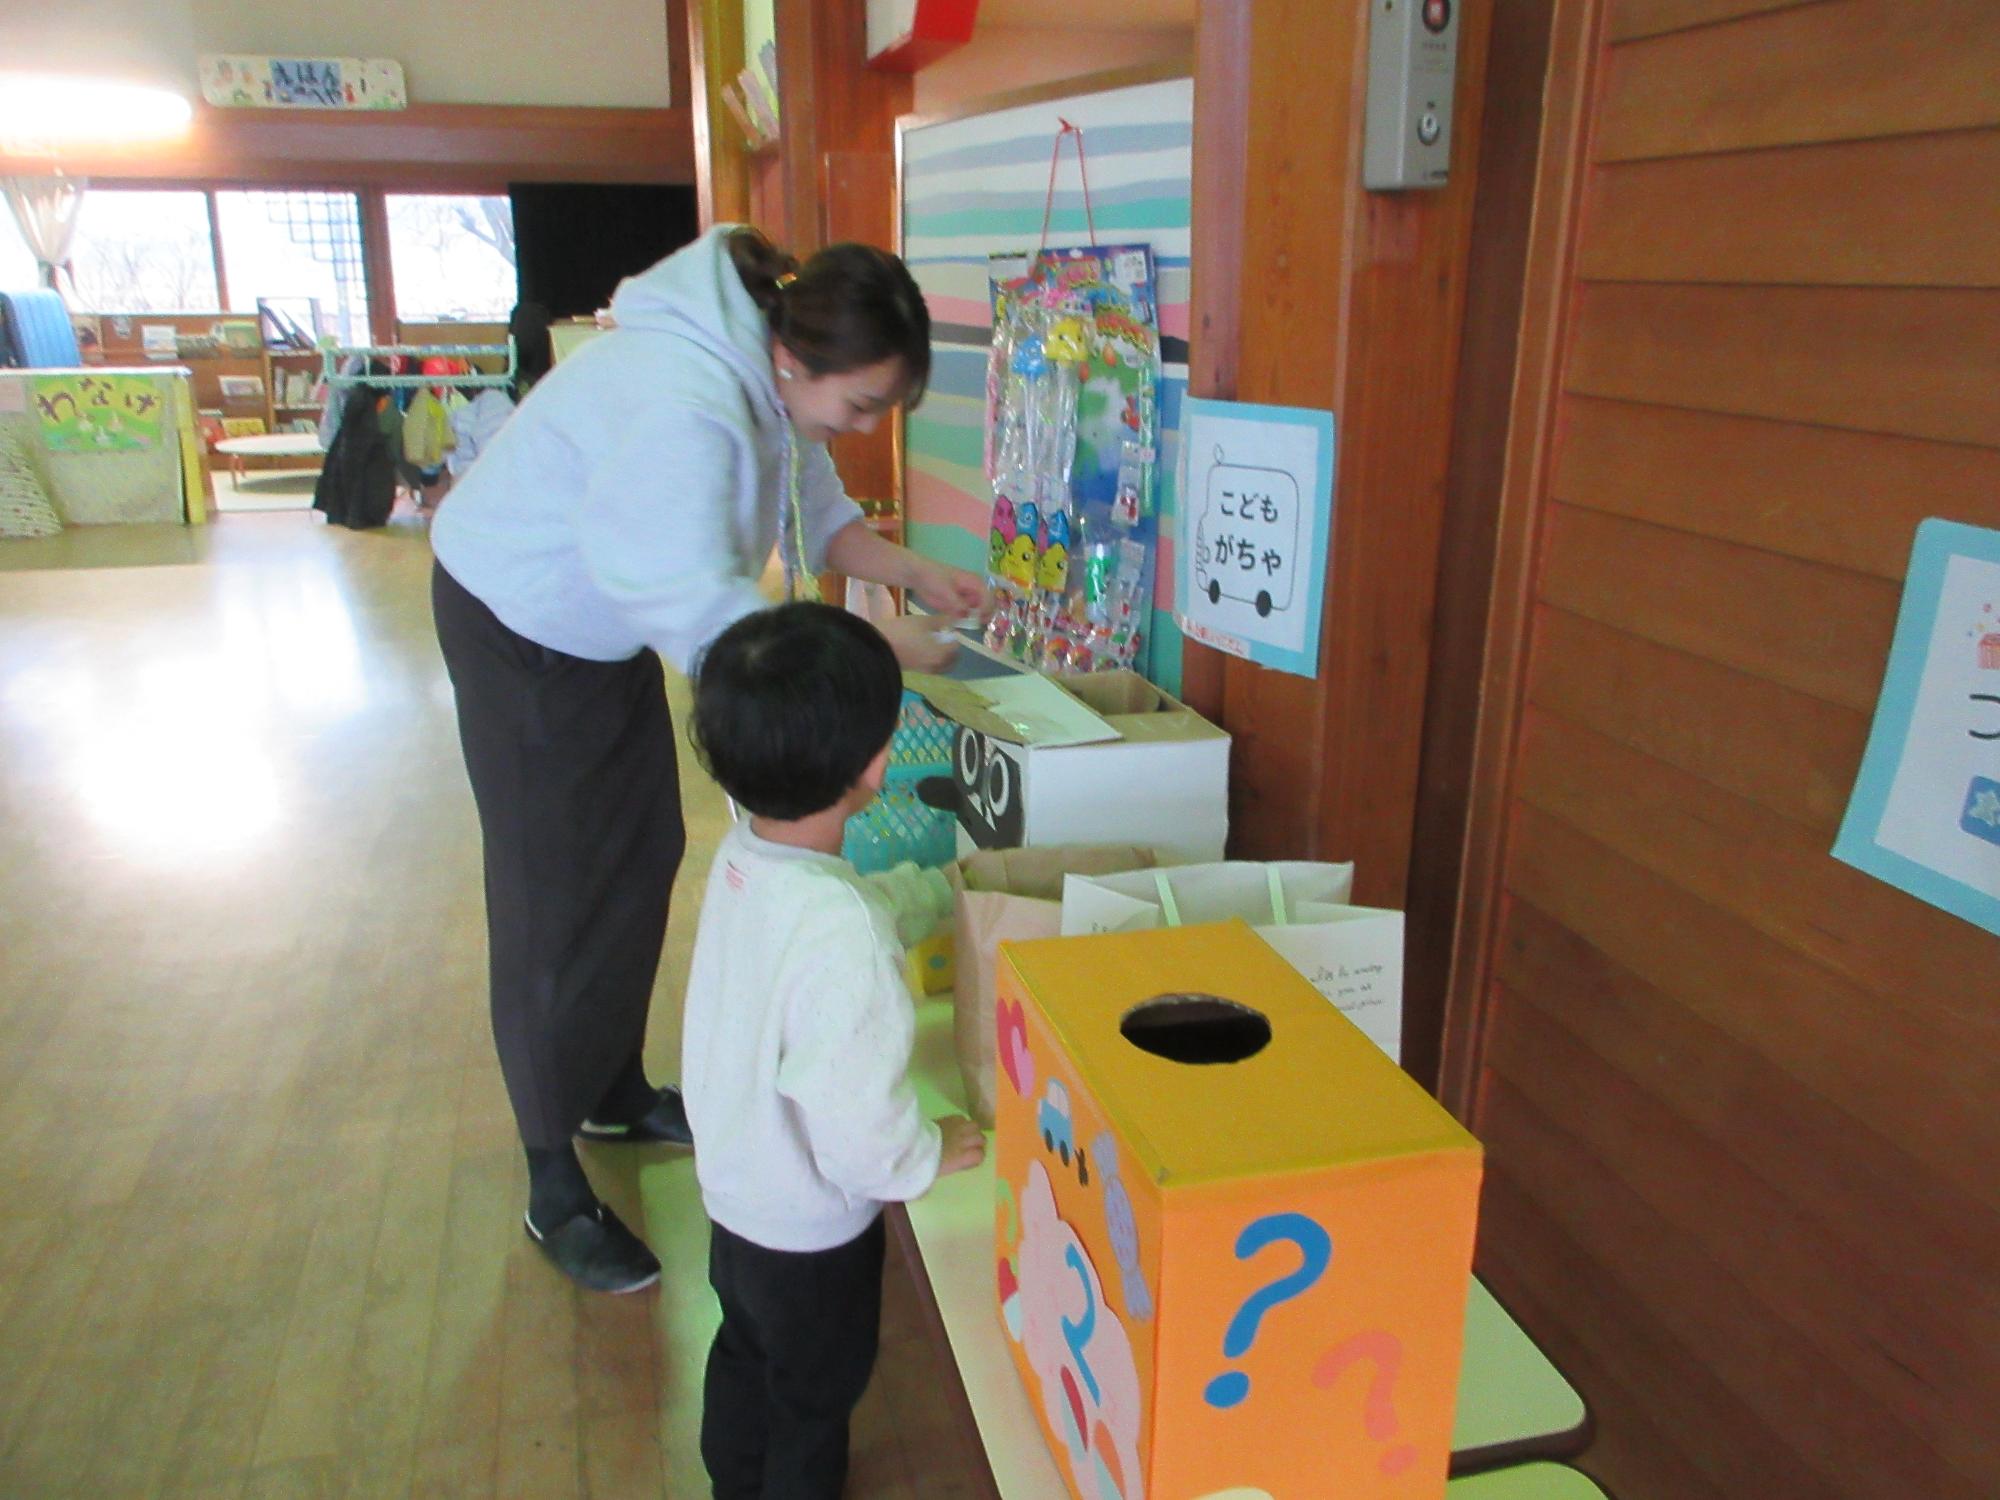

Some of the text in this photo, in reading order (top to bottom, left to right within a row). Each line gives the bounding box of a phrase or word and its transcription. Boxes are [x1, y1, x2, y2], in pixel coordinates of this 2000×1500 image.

[1220, 491, 1278, 523] こども
[1214, 534, 1282, 577] がちゃ
